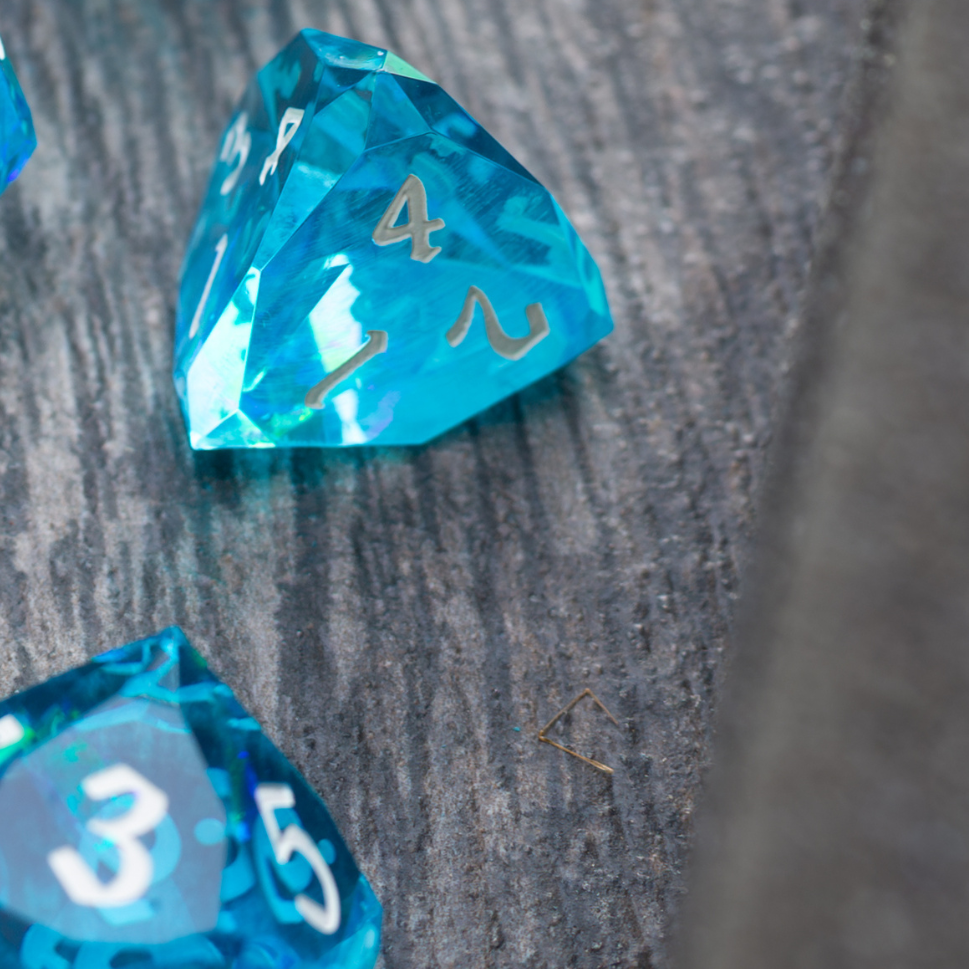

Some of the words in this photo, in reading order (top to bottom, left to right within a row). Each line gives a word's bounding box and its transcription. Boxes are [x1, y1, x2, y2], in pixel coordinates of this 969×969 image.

[372, 174, 446, 264] 4
[445, 285, 550, 361] 2
[304, 330, 389, 410] 1
[47, 763, 169, 907] 3
[254, 783, 341, 935] 5
